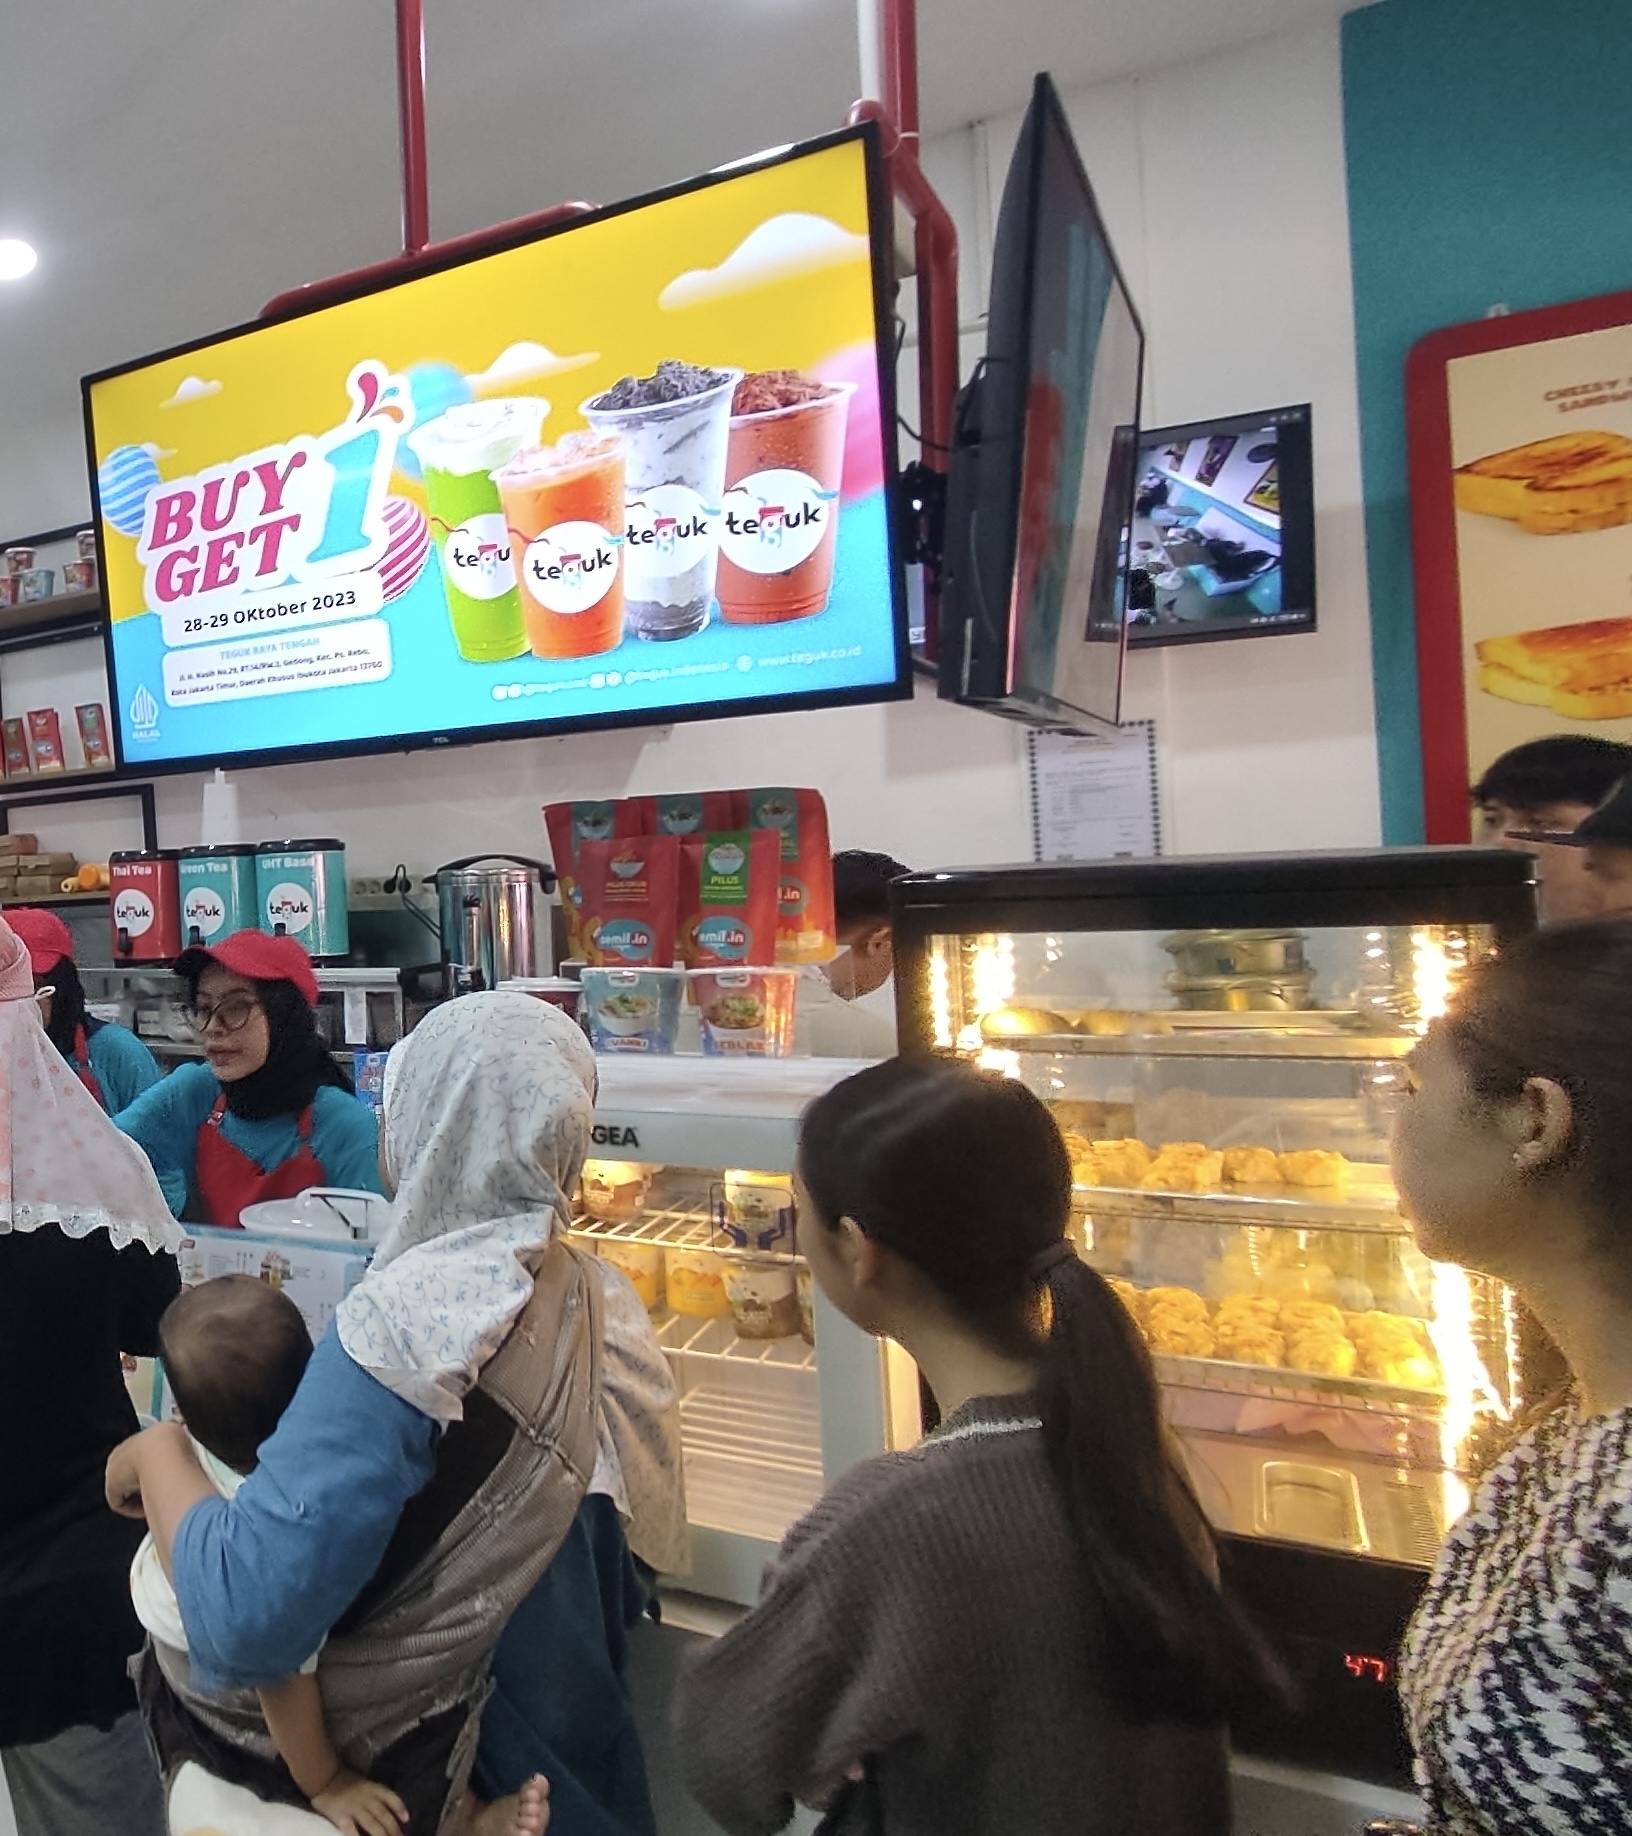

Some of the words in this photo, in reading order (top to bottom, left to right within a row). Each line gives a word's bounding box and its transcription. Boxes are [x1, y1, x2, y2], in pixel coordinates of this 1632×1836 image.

[148, 452, 307, 550] BUY
[306, 427, 380, 563] 1
[155, 514, 302, 602] GET
[453, 541, 511, 577] tegu
[184, 613, 229, 632] 28-29
[312, 591, 356, 611] 2023
[220, 647, 250, 660] TEGUK
[253, 643, 277, 656] RAYA
[280, 637, 320, 651] TENGAH
[188, 684, 215, 694] Jakarta
[327, 665, 358, 676] Jakarta
[113, 866, 131, 876] Thai
[132, 865, 152, 875] Tea
[206, 861, 228, 872] Tea
[262, 857, 282, 869] UHT
[591, 1125, 640, 1148] GEA
